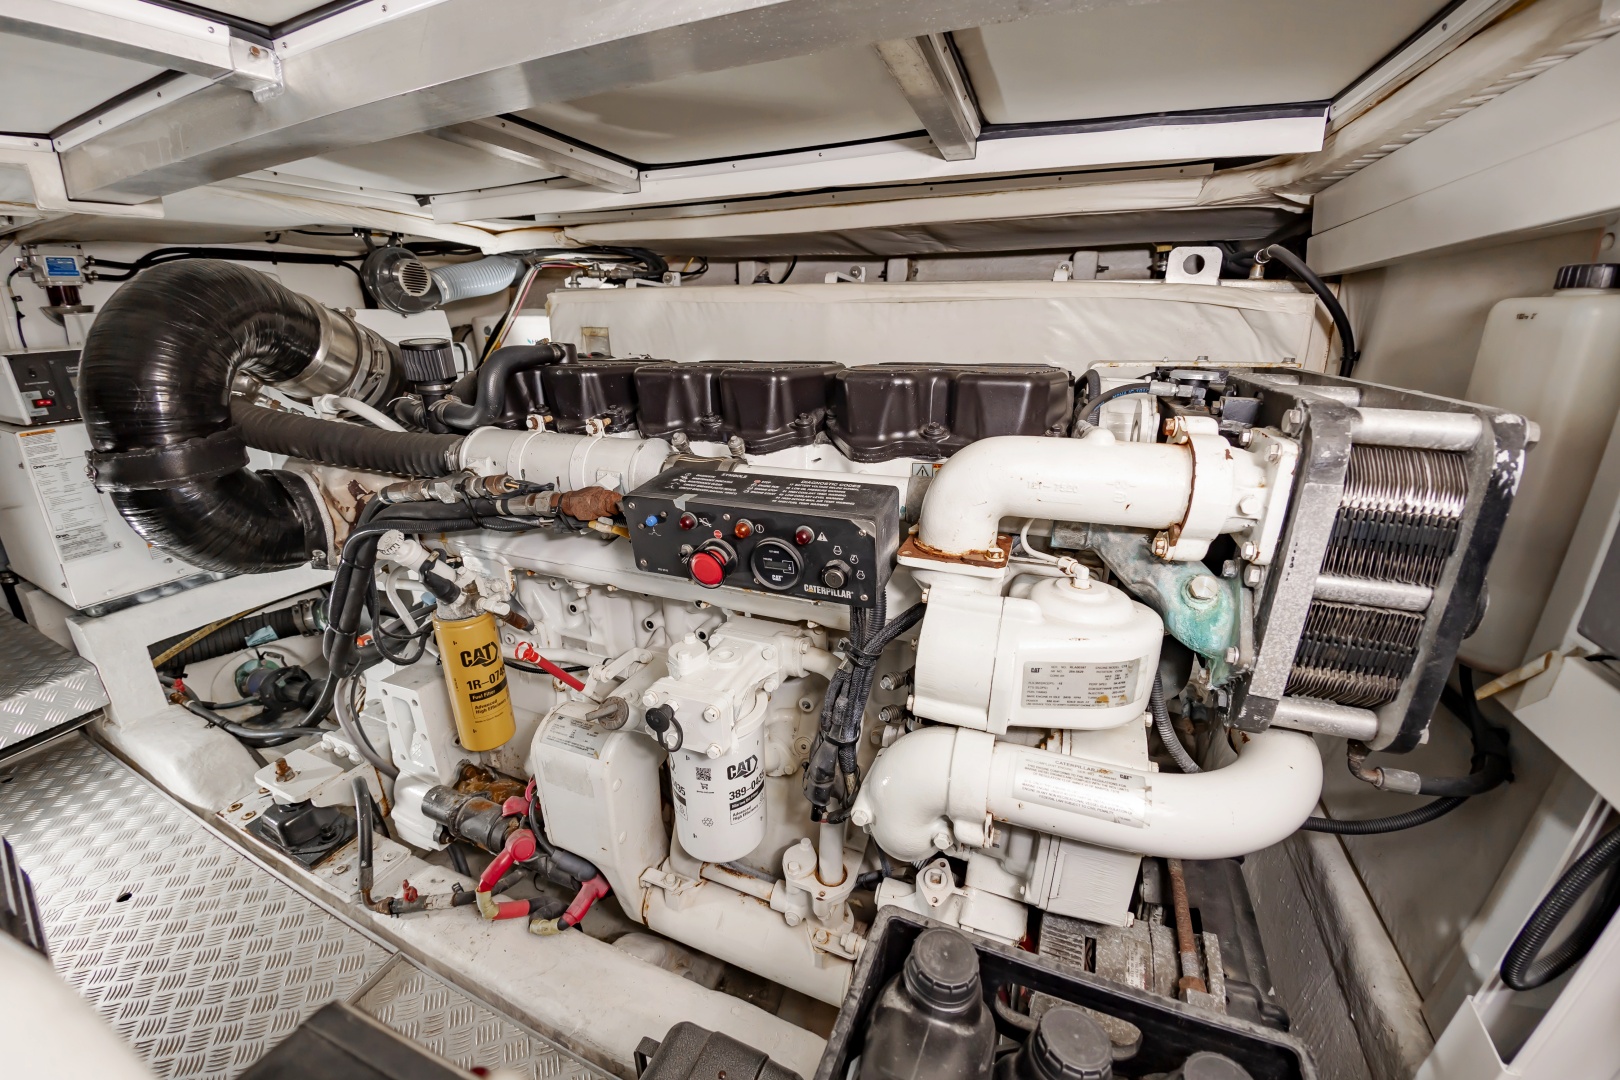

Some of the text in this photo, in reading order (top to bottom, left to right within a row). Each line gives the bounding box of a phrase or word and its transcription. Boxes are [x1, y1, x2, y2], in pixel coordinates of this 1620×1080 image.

[804, 584, 852, 599] CATERPILLAR
[460, 642, 498, 667] CAT
[475, 699, 498, 710] Advanced
[727, 755, 758, 780] CAT
[1055, 761, 1095, 772] CATERPILLAR
